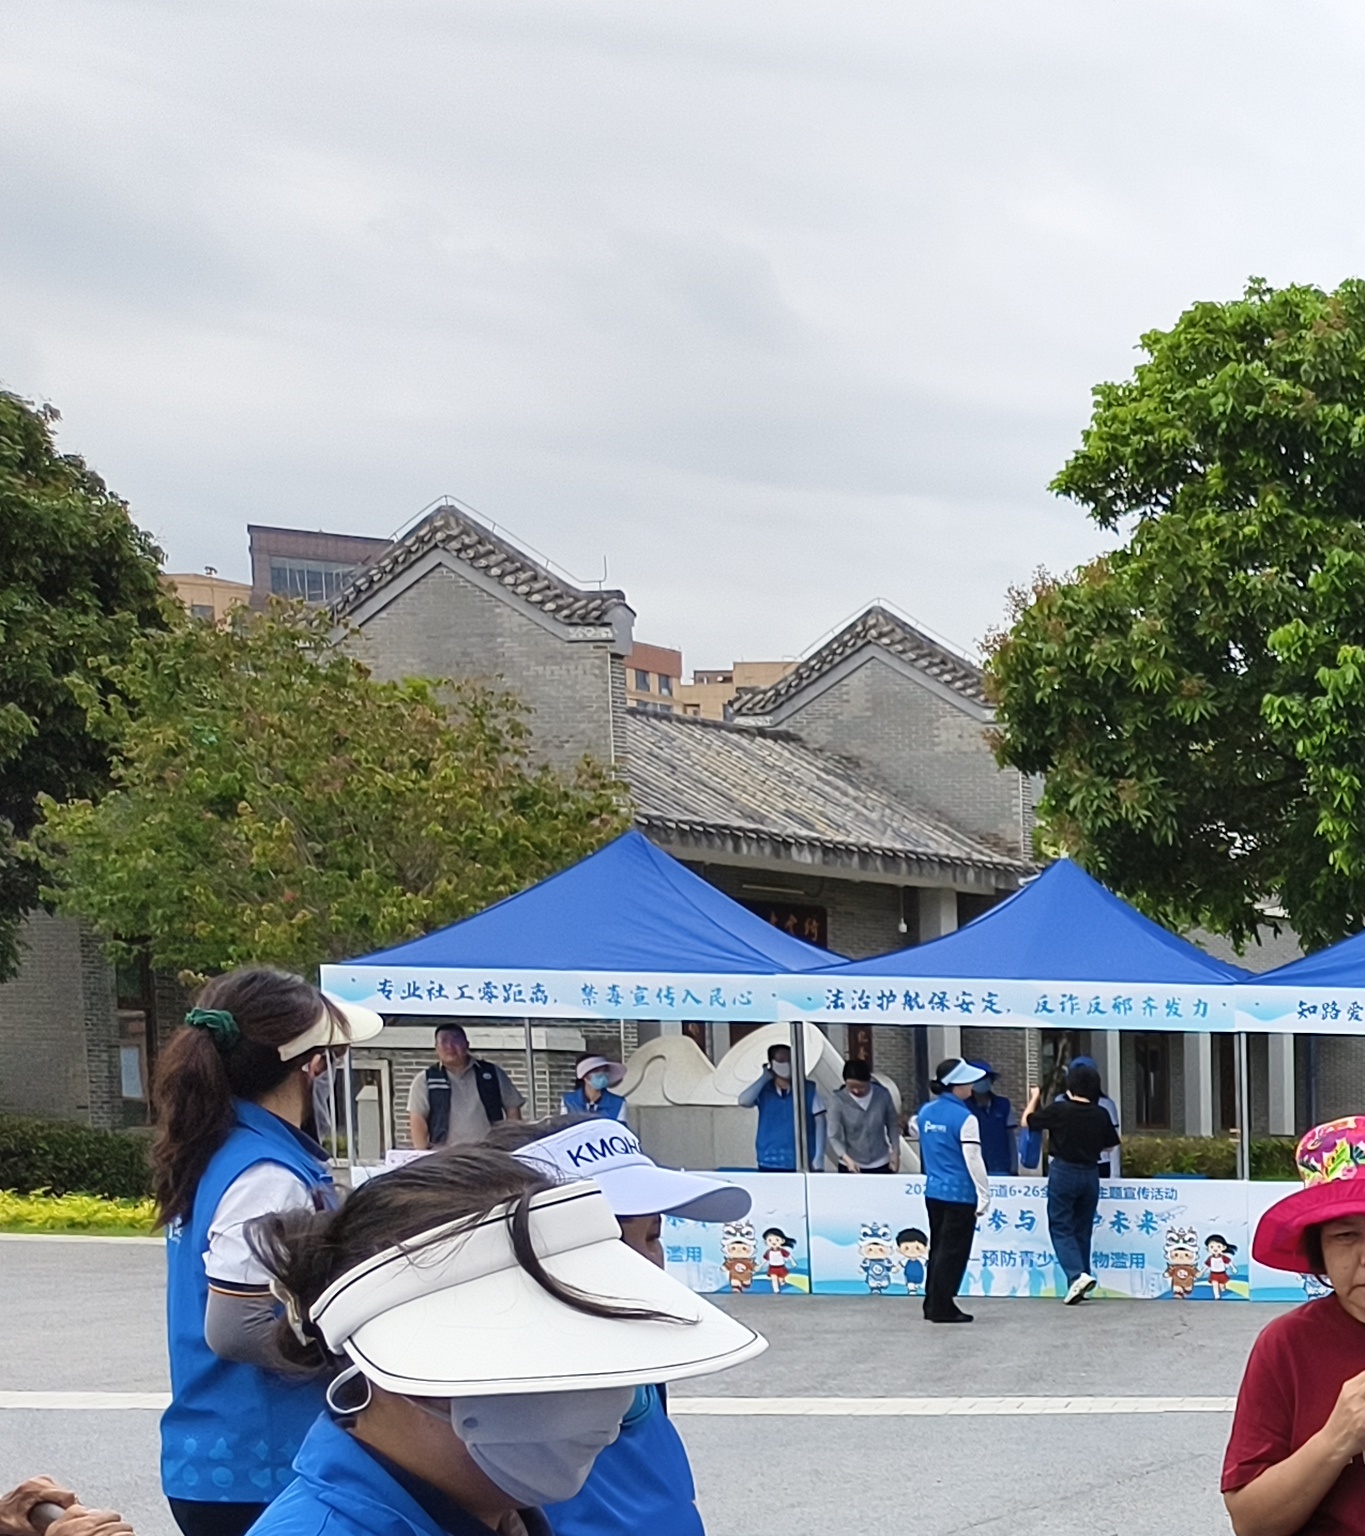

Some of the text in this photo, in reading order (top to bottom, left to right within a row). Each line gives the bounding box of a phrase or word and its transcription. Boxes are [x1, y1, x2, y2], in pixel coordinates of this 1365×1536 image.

[581, 983, 753, 1008] 禁毒宣传入民心
[1034, 994, 1210, 1018] 反诈反邪齐发力
